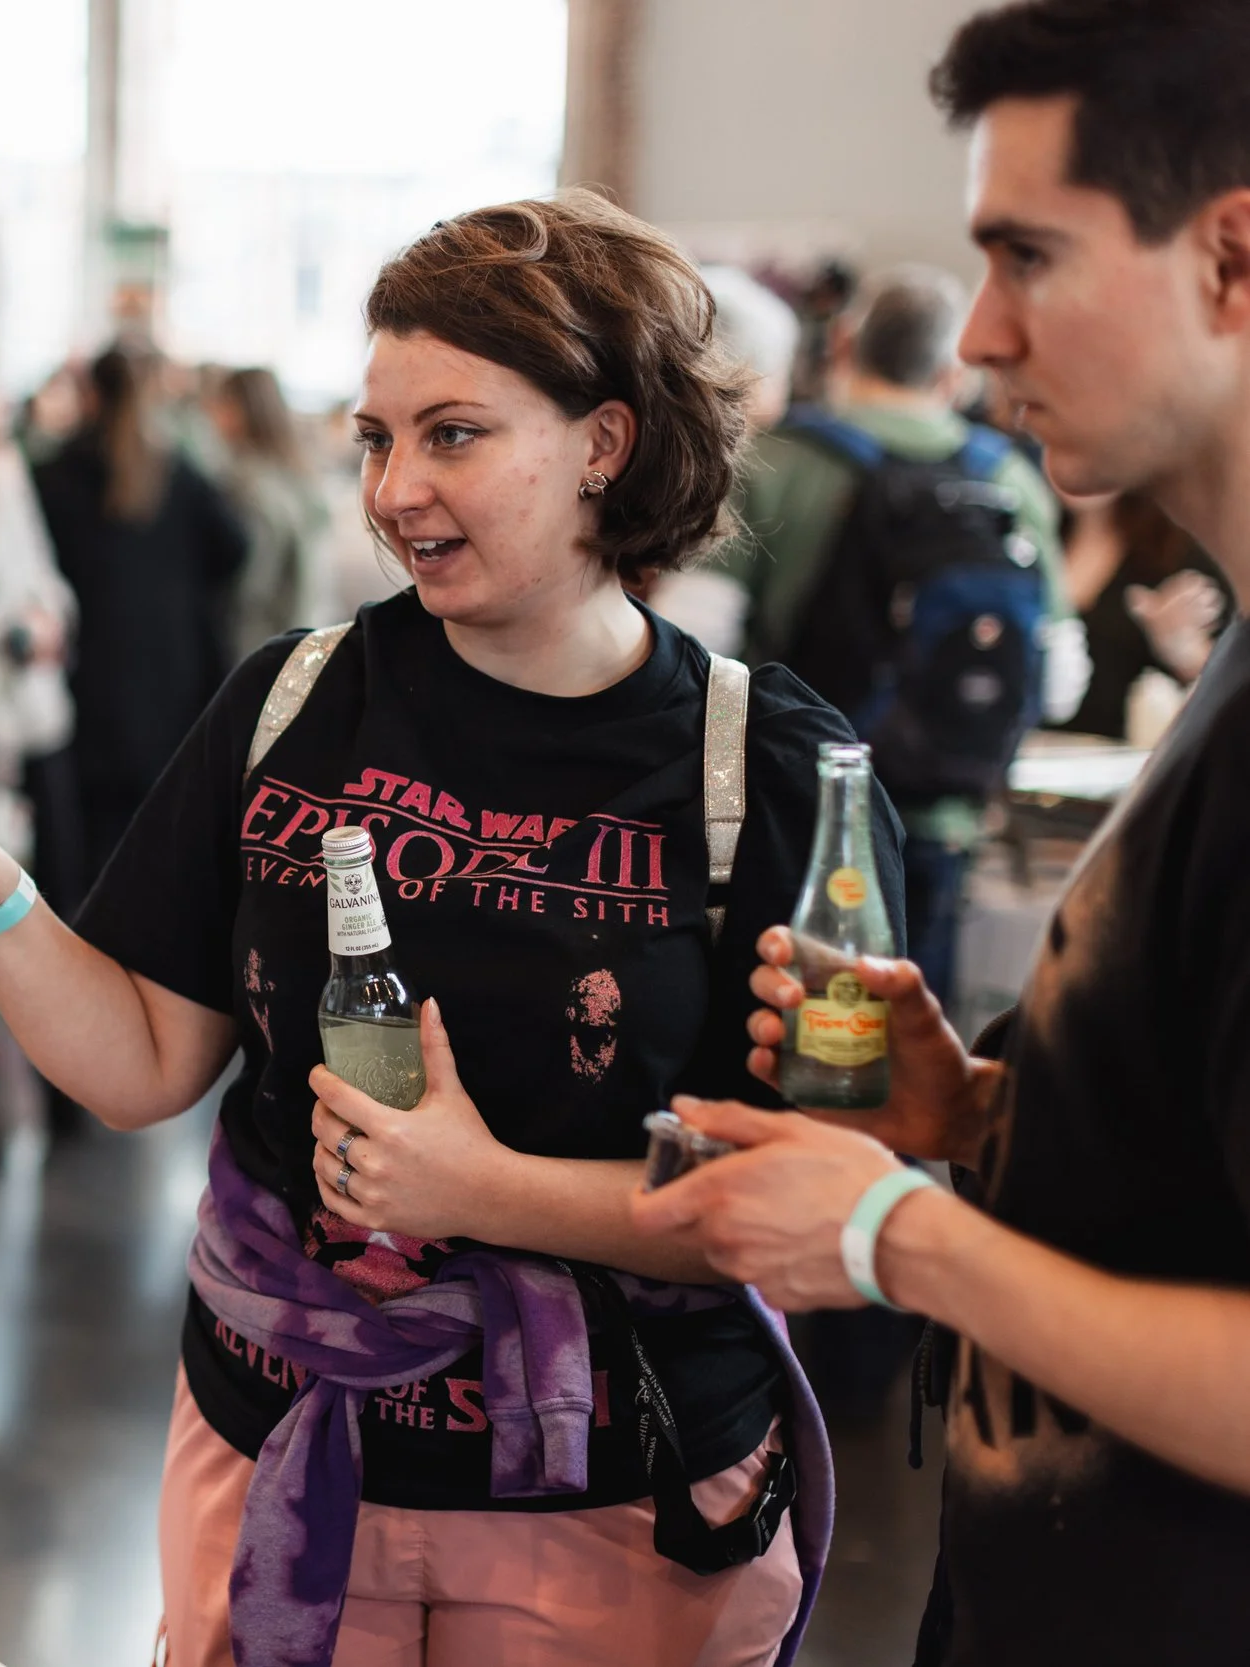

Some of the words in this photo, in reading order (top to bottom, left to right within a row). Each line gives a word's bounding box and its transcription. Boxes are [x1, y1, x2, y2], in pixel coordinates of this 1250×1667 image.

[343, 767, 472, 832] STAR
[481, 809, 580, 843] WAR
[246, 856, 327, 889] EVEN
[398, 878, 447, 902] OF
[471, 880, 546, 914] THE
[572, 896, 670, 928] SITH
[581, 824, 670, 891] III
[375, 1397, 436, 1430] THE
